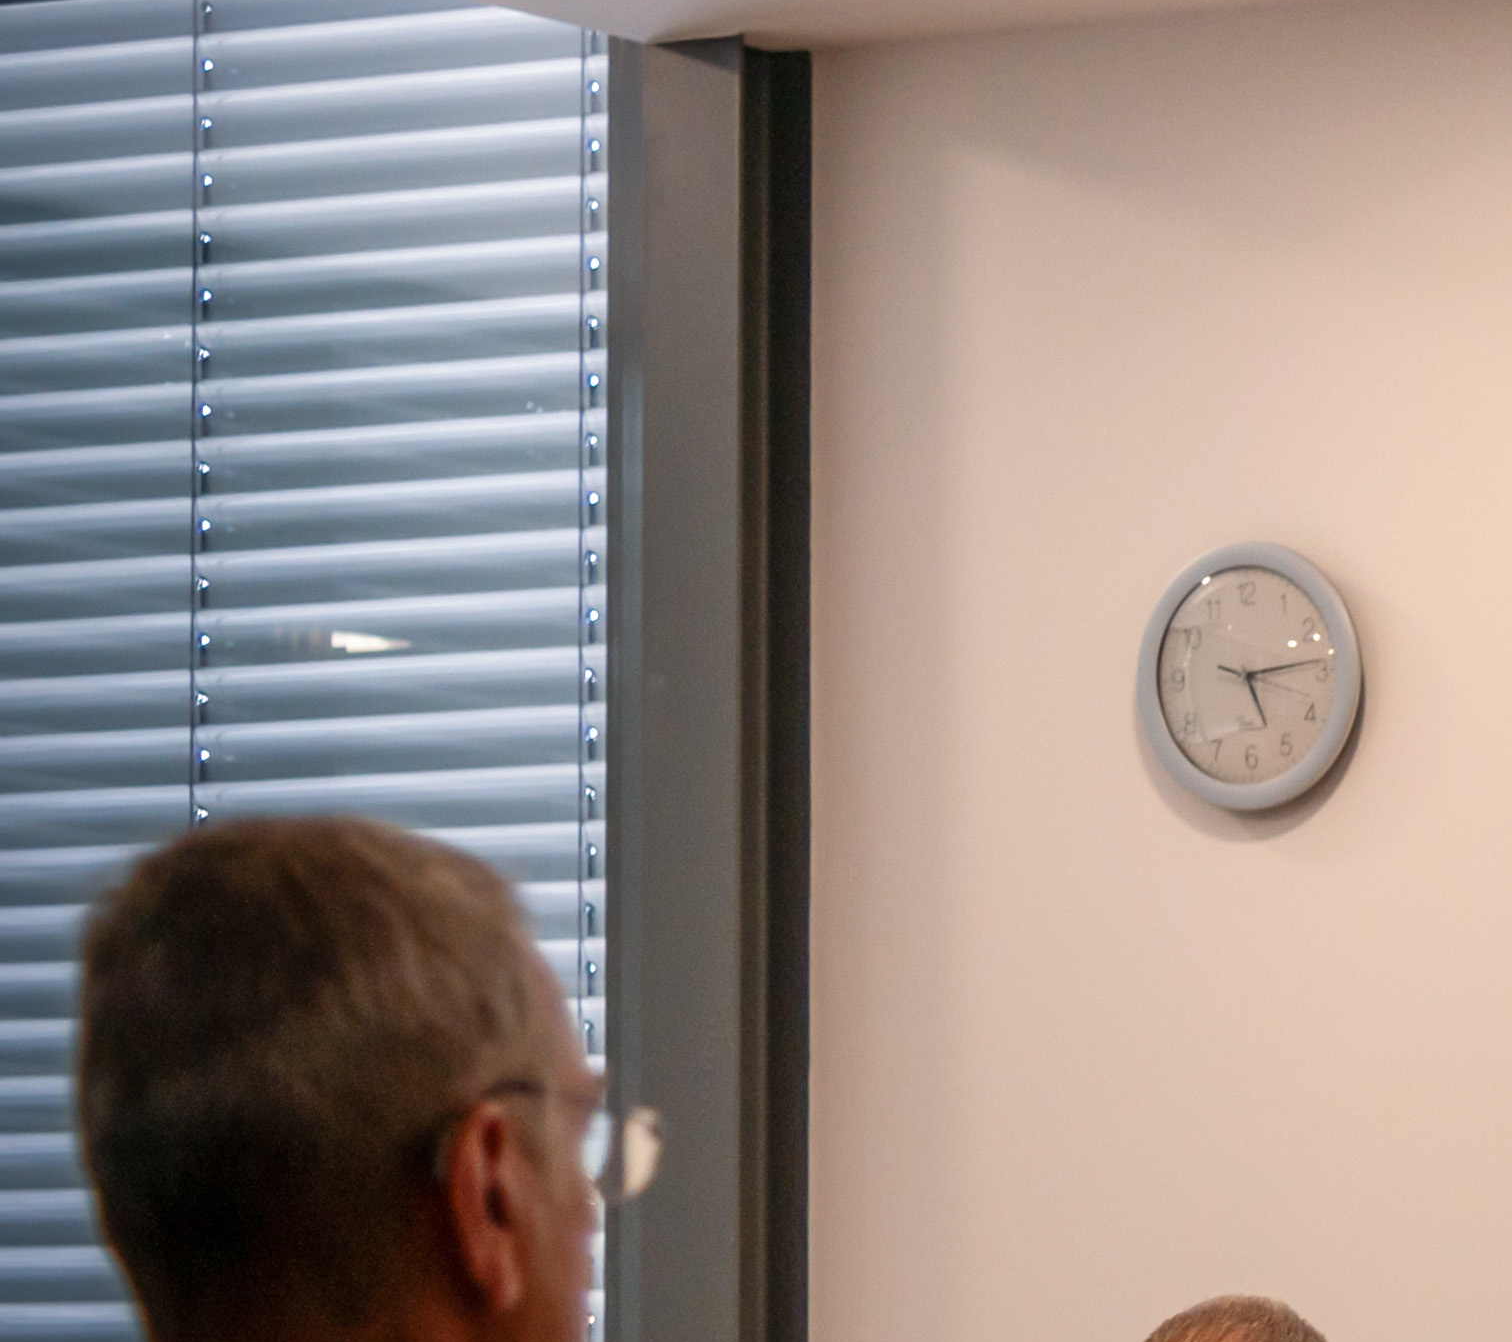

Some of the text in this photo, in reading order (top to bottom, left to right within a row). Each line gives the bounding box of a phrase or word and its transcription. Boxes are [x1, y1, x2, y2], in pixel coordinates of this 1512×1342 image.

[1237, 581, 1256, 607] 12
[1280, 593, 1288, 614] 1
[1206, 599, 1222, 620] 11
[1302, 617, 1317, 643] 2
[1171, 668, 1186, 693] 9
[1314, 660, 1329, 683] 3
[1183, 711, 1197, 736] 8
[1303, 702, 1316, 723] 4
[1211, 739, 1224, 761] 7
[1245, 744, 1259, 770] 6
[1279, 733, 1293, 757] 5
